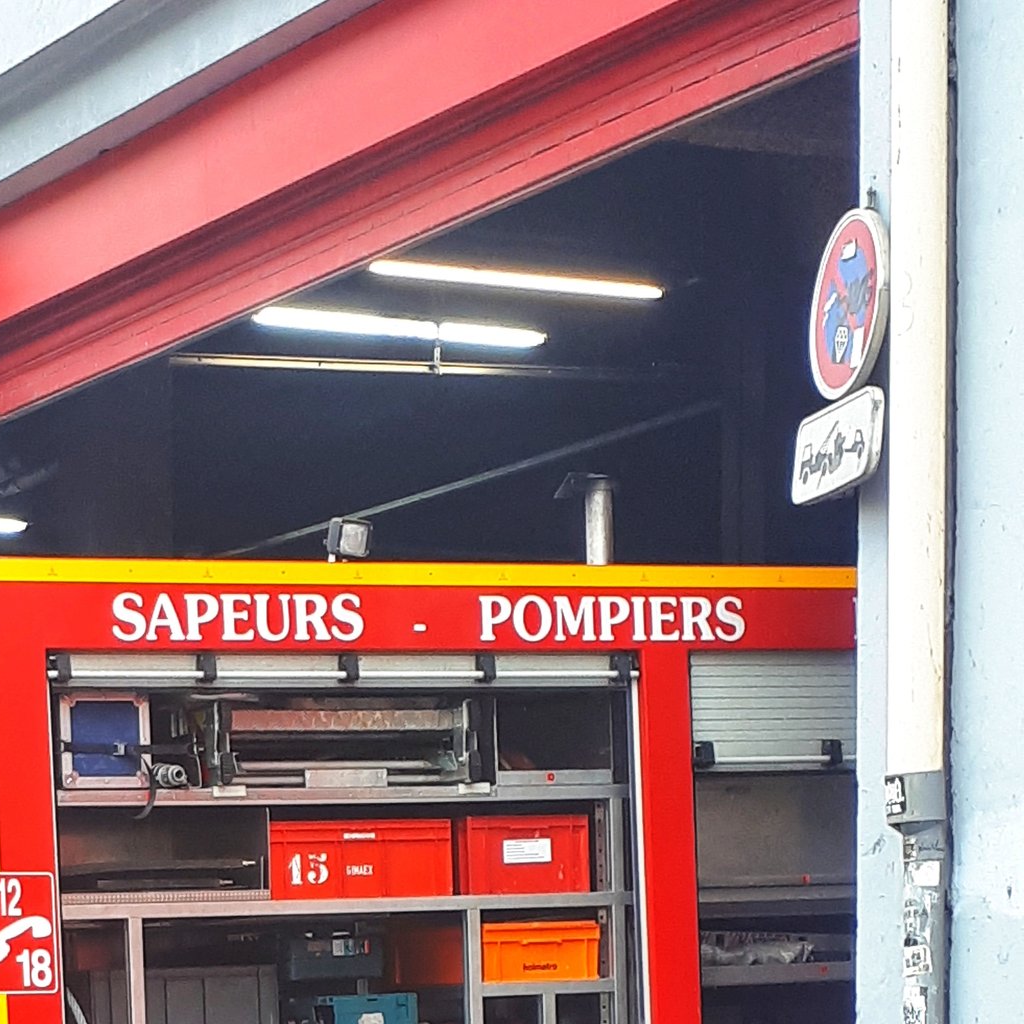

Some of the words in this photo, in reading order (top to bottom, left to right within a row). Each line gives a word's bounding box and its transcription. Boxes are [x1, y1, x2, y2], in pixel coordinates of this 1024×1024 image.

[111, 591, 365, 642] SAPEURS
[478, 594, 746, 642] POMPIERS
[287, 852, 330, 886] 15
[15, 948, 53, 988] 18
